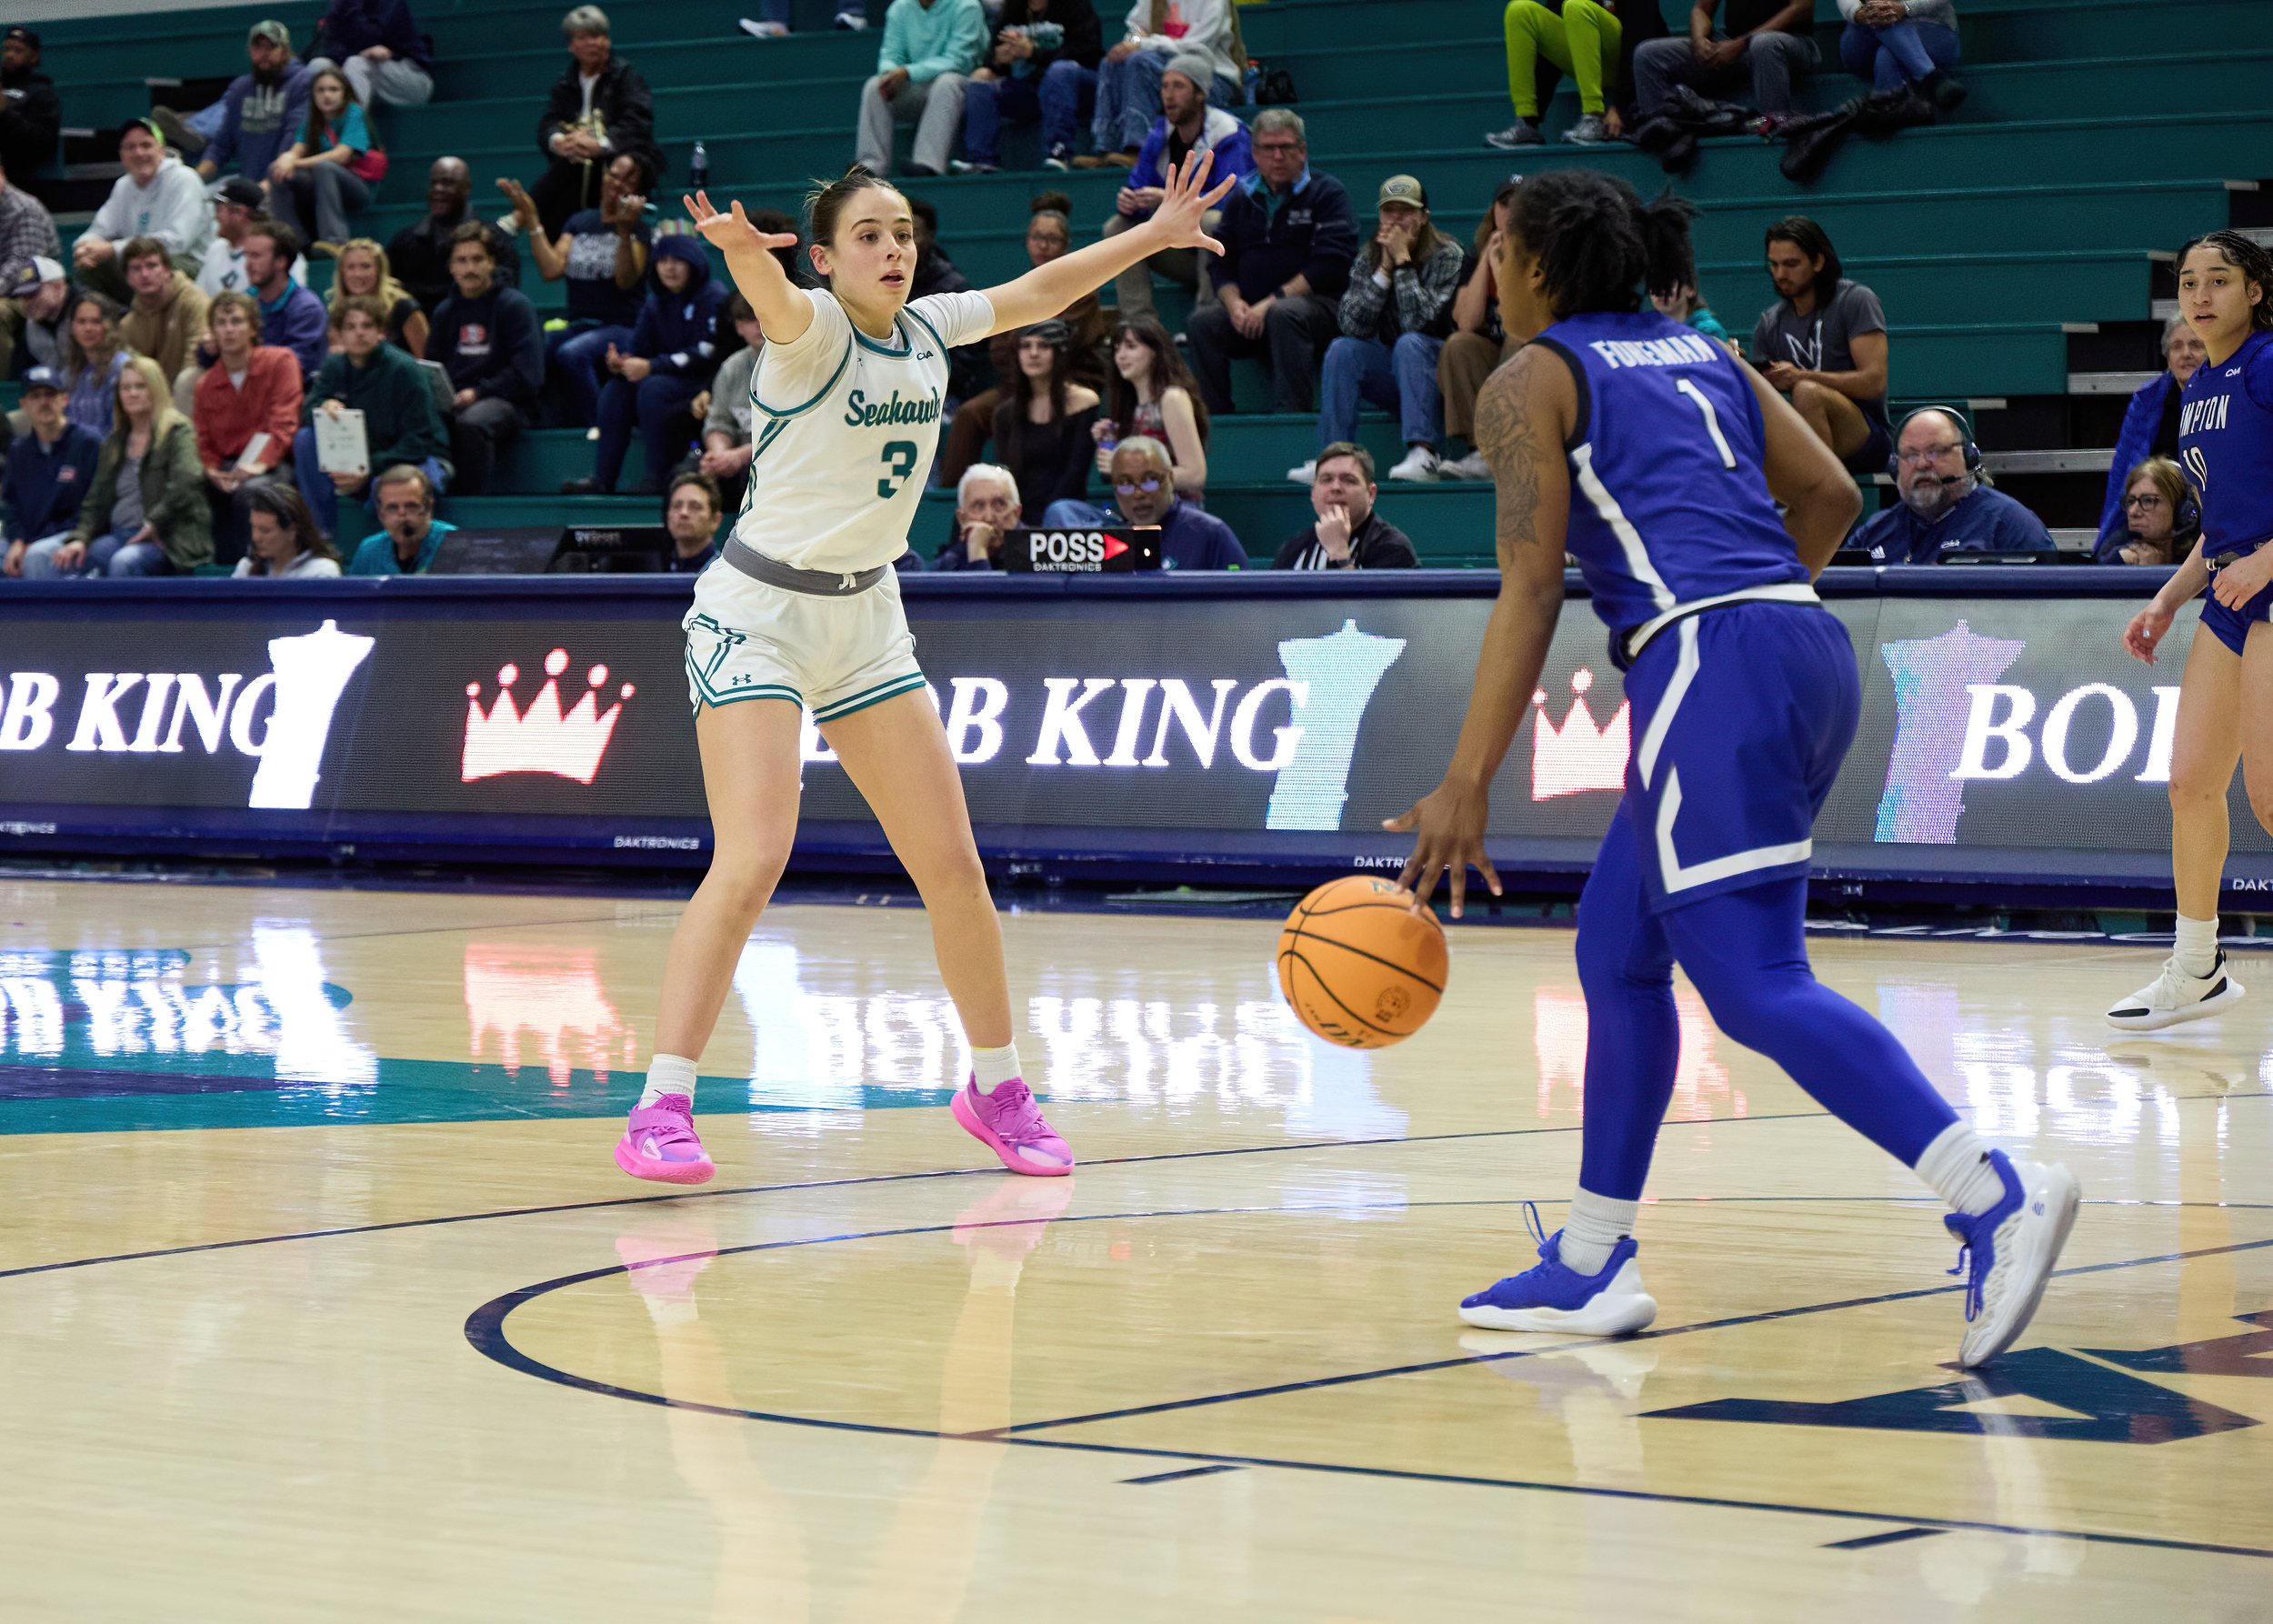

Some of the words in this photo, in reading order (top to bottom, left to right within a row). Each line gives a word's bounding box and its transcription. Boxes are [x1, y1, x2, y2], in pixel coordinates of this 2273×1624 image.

[1588, 334, 1718, 369] FOREMAN
[1676, 378, 1737, 468] 1
[2179, 395, 2230, 439] MPTON
[877, 440, 918, 499] 3
[1029, 532, 1106, 562] POSS
[1033, 562, 1102, 572] DAKTRONICS
[65, 672, 276, 757] KING
[1026, 677, 1310, 771] KING
[614, 836, 700, 849] DAKTRONICS
